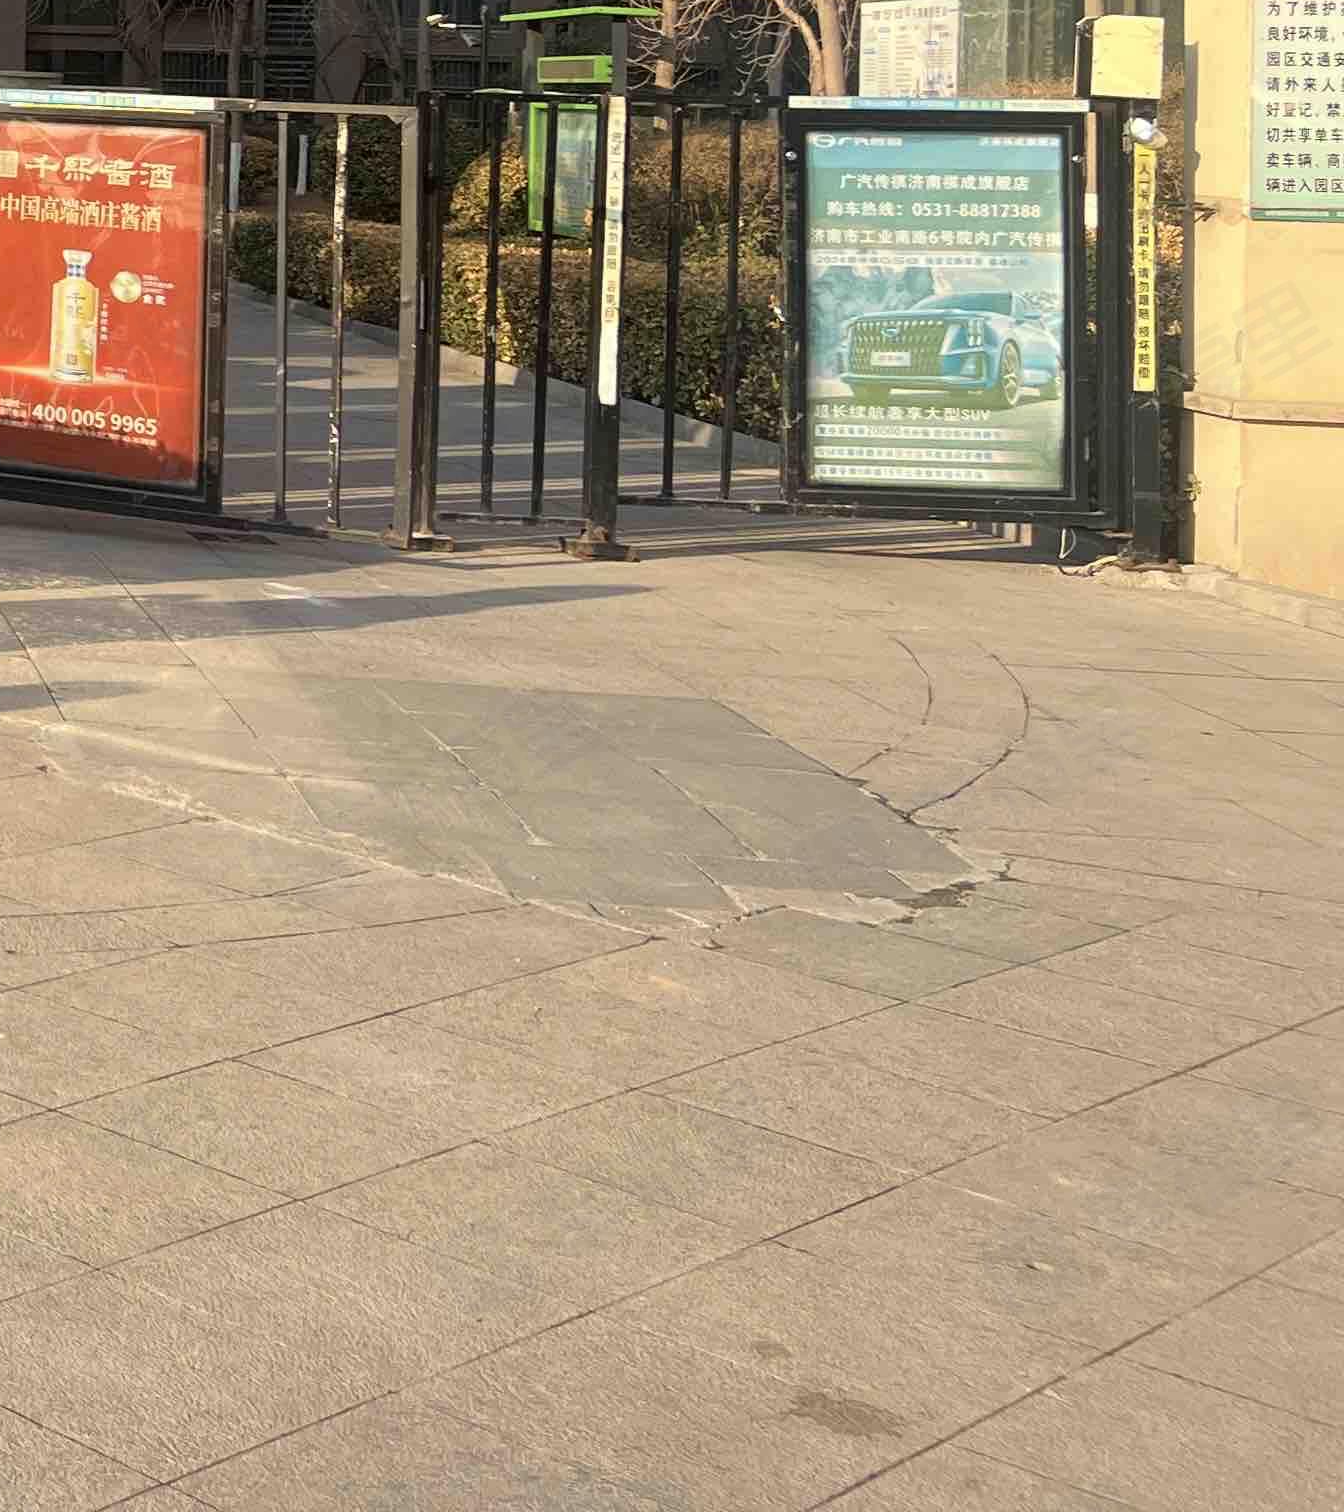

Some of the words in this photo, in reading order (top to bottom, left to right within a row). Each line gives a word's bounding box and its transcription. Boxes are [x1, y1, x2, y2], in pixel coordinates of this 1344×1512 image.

[1265, 0, 1344, 17] 为了维护
[1266, 26, 1344, 42] 良好环境，
[1265, 77, 1344, 93] 请外来人
[1265, 152, 1344, 169] 卖车辆、商
[1265, 177, 1344, 193] 辆进入园区
[0, 192, 162, 233] 中国高端酒庄酱酒
[32, 404, 67, 424] 400
[71, 408, 106, 429] 005
[110, 414, 159, 437] 9965
